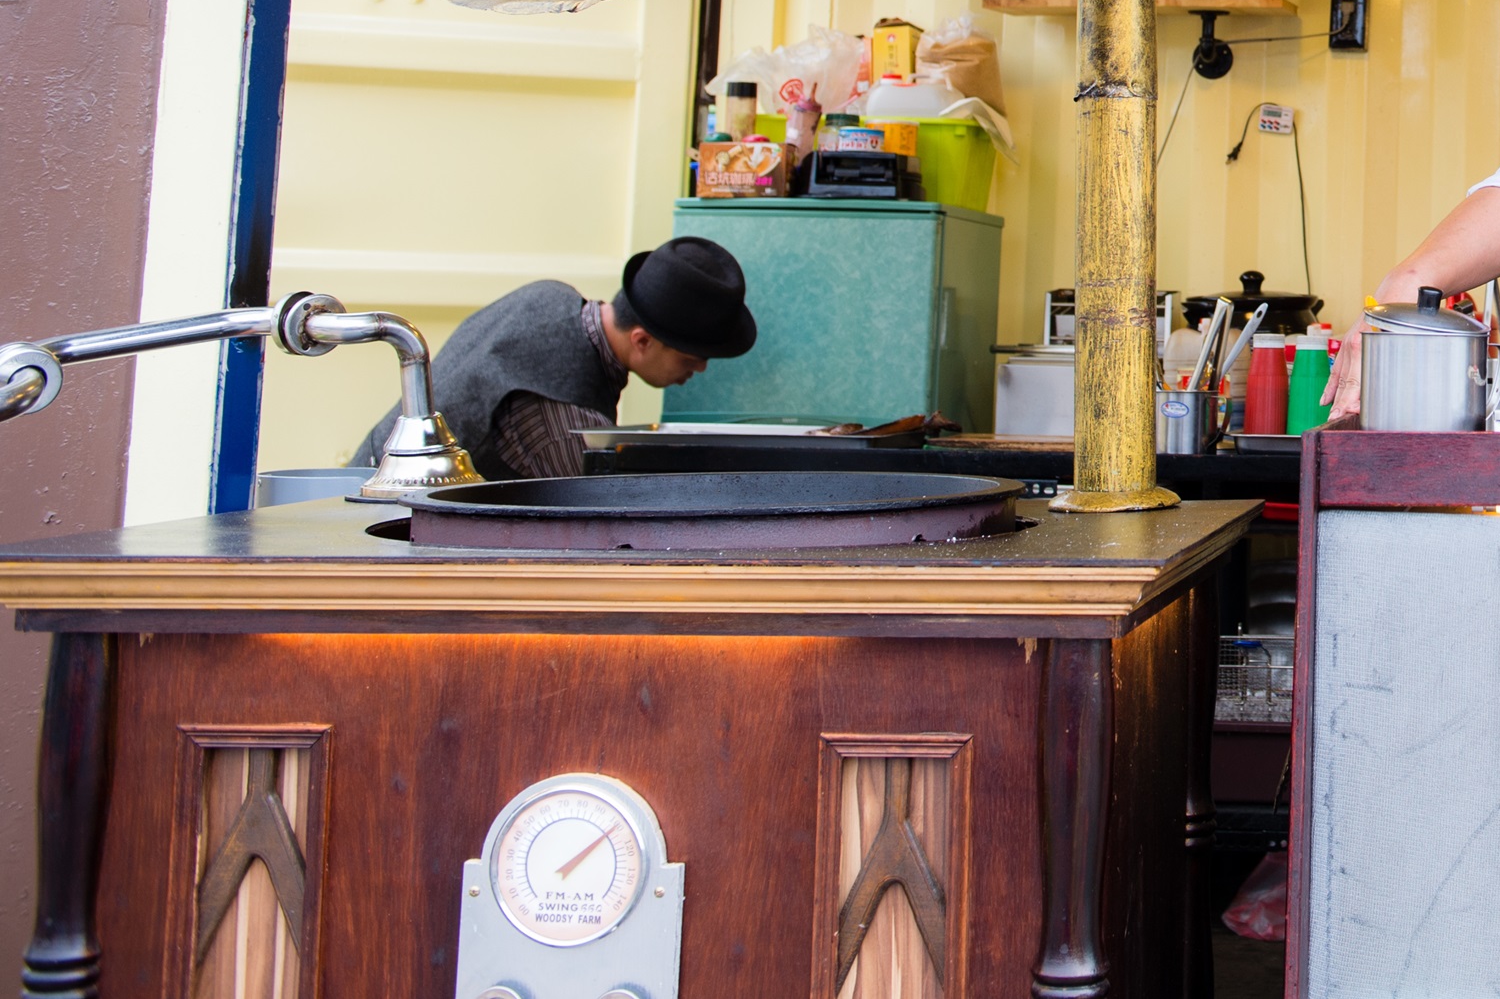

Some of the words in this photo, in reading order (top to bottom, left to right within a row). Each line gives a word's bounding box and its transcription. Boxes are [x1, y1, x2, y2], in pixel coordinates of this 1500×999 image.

[540, 804, 551, 815] 60
[558, 799, 570, 808] 70
[576, 799, 589, 808] 80
[595, 804, 606, 815] 90
[523, 815, 535, 828] 50
[513, 831, 523, 843] 40
[624, 839, 635, 857] 120
[506, 848, 515, 861] 30
[505, 868, 514, 881] 20
[626, 867, 636, 886] 130
[508, 887, 519, 899] 10
[538, 902, 579, 912] SWING
[613, 893, 627, 911] 140
[535, 913, 573, 924] WOODSY
[577, 914, 602, 925] FARM
